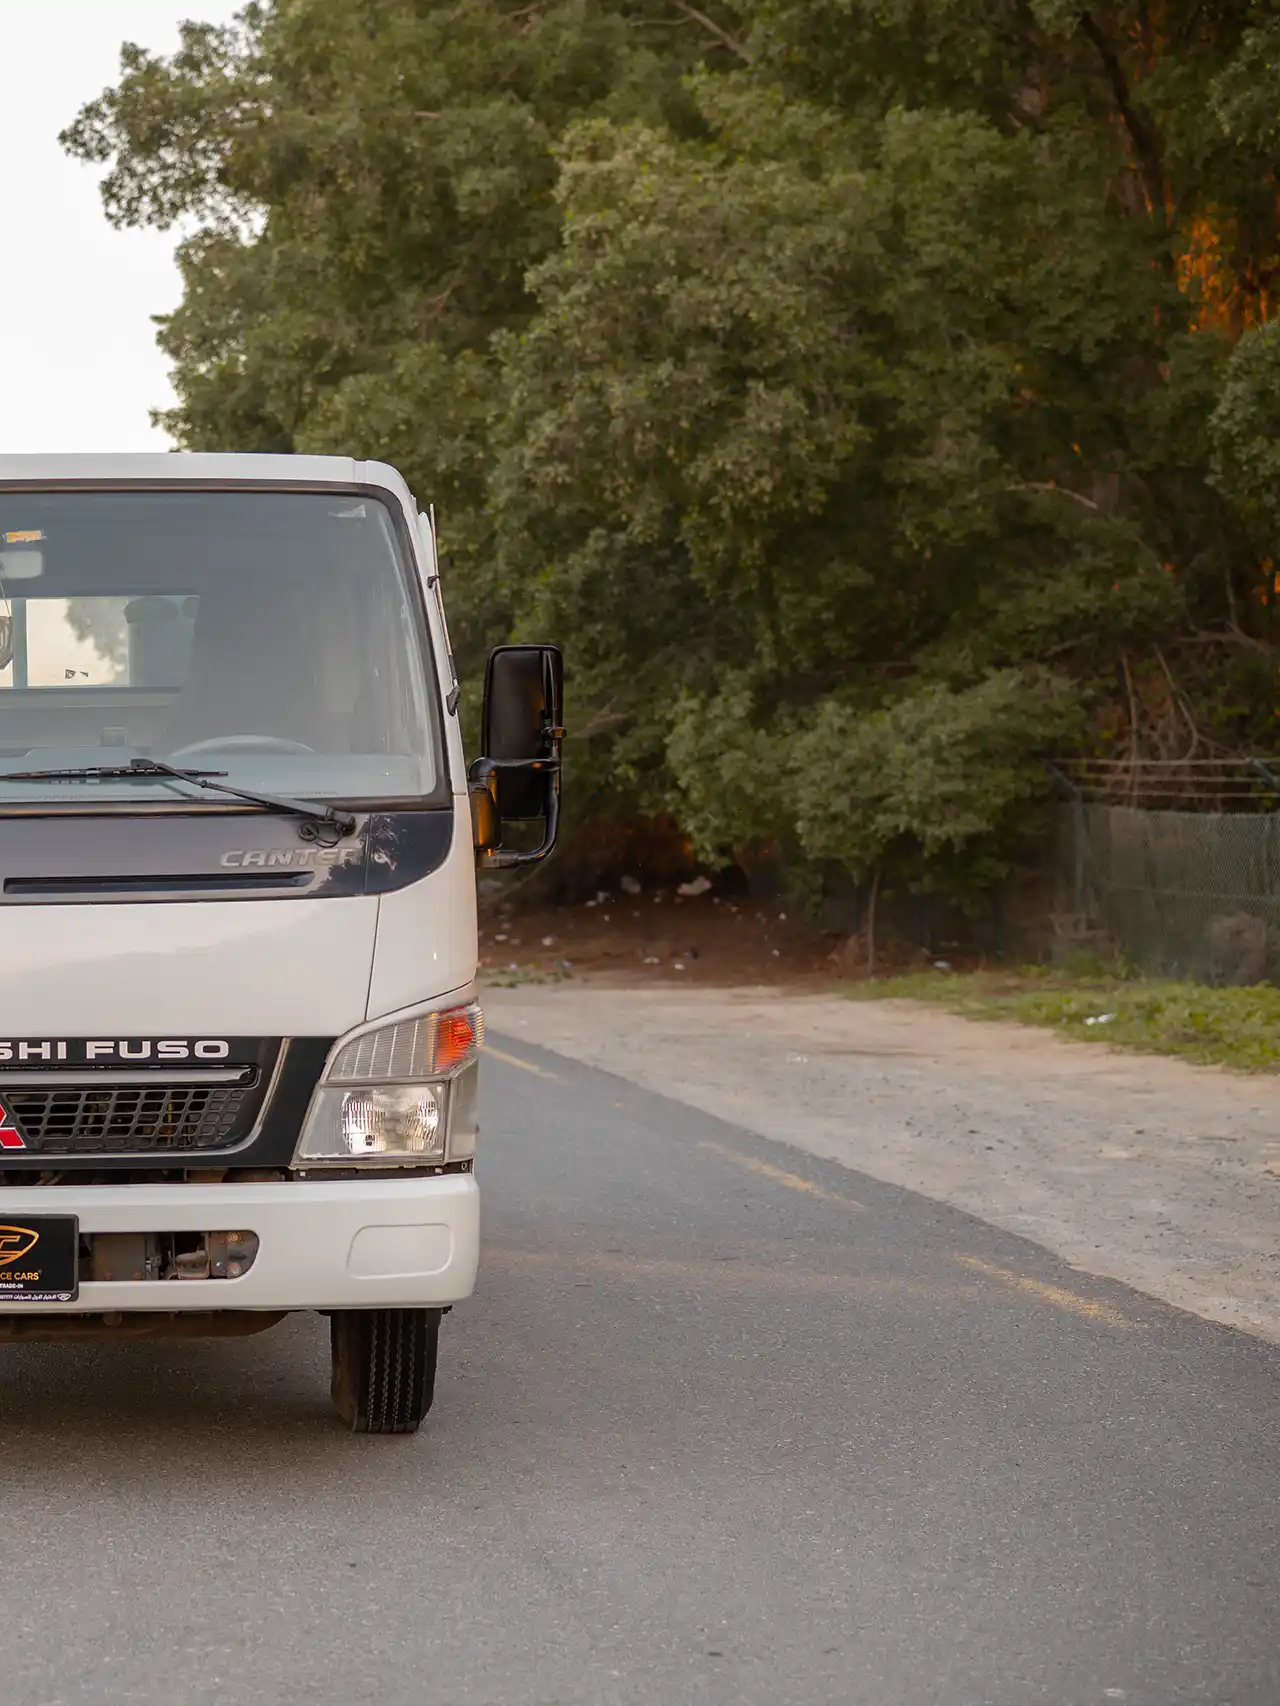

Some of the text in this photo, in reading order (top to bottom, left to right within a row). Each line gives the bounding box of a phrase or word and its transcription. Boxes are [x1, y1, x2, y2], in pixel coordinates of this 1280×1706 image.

[220, 847, 363, 868] CANTER
[86, 1040, 230, 1060] FUSO
[14, 1271, 39, 1280] CARS
